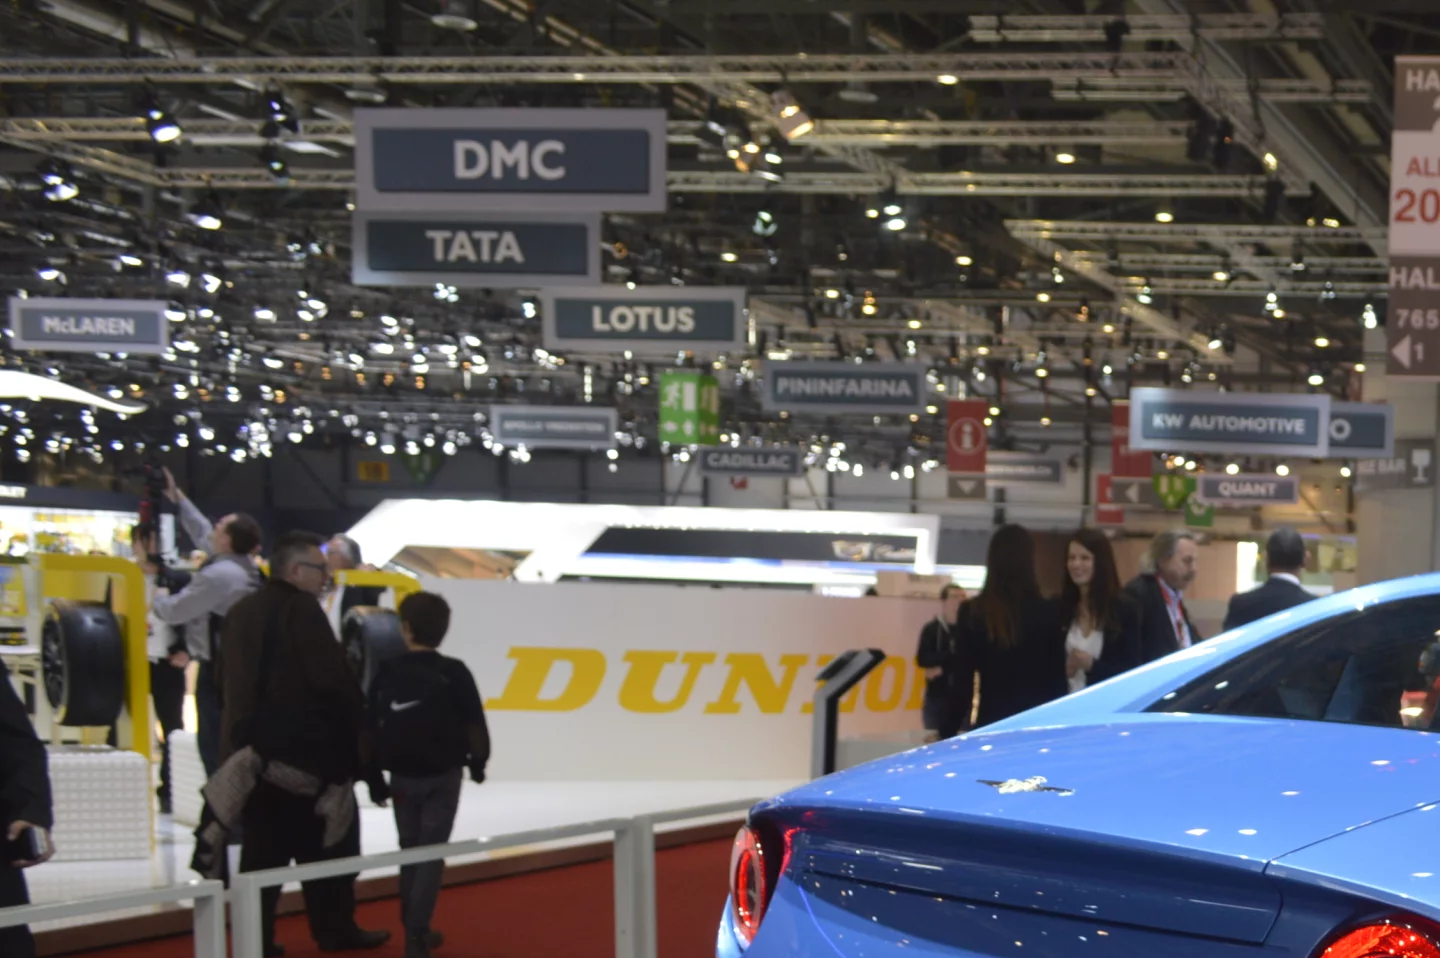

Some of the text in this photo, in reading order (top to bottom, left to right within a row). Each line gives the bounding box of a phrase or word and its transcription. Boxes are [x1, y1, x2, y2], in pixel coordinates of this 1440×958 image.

[453, 139, 567, 181] DMC
[425, 229, 525, 264] TATA
[41, 315, 137, 337] McLAREN
[592, 304, 696, 333] LOTUS
[1413, 341, 1425, 362] 1
[776, 376, 913, 398] PININFARINA
[1152, 411, 1306, 436] KW AUTOMOTIVE
[706, 452, 792, 470] CADILLAC
[1218, 480, 1278, 498] QUANT
